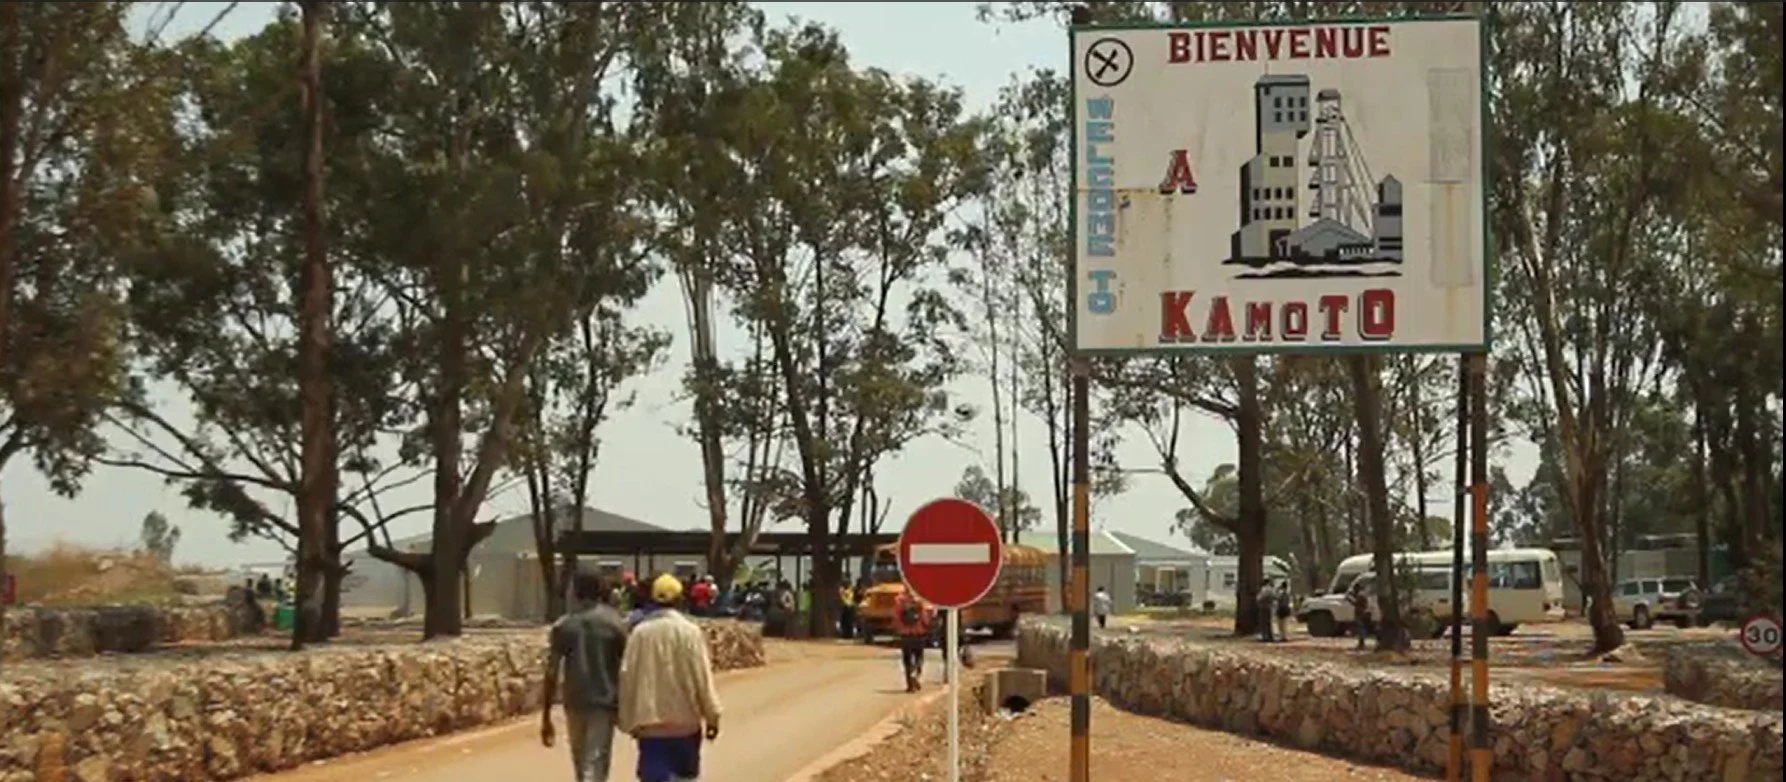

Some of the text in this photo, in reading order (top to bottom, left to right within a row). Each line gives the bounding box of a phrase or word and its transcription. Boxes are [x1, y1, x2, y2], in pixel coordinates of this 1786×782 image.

[1168, 27, 1391, 64] BIENVENUE
[1158, 149, 1198, 195] A
[1086, 95, 1117, 315] WELCOME TO
[1158, 288, 1396, 344] KAMOTO
[1747, 625, 1778, 645] 30
